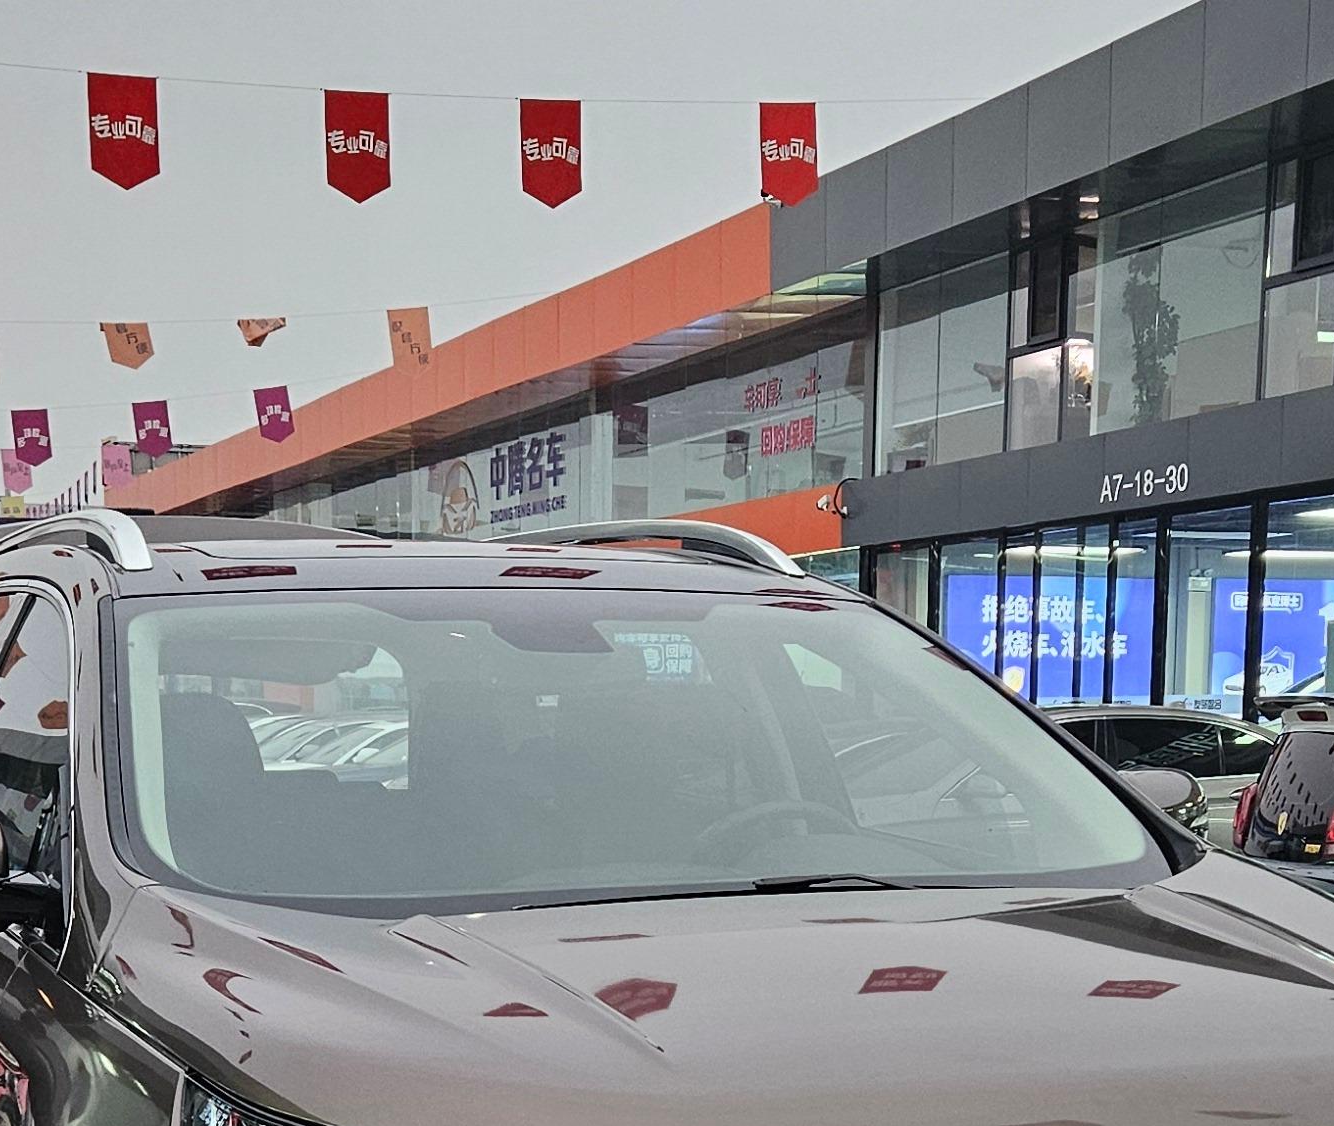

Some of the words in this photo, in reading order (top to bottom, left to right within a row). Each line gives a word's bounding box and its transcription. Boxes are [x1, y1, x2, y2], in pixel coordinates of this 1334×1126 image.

[91, 114, 156, 145] 专业可靠
[327, 130, 387, 159] 专业可靠
[522, 137, 579, 165] 专业可靠
[762, 138, 815, 164] 专业可靠
[490, 432, 566, 500] 中腾名车
[1100, 463, 1189, 504] A7-18-30
